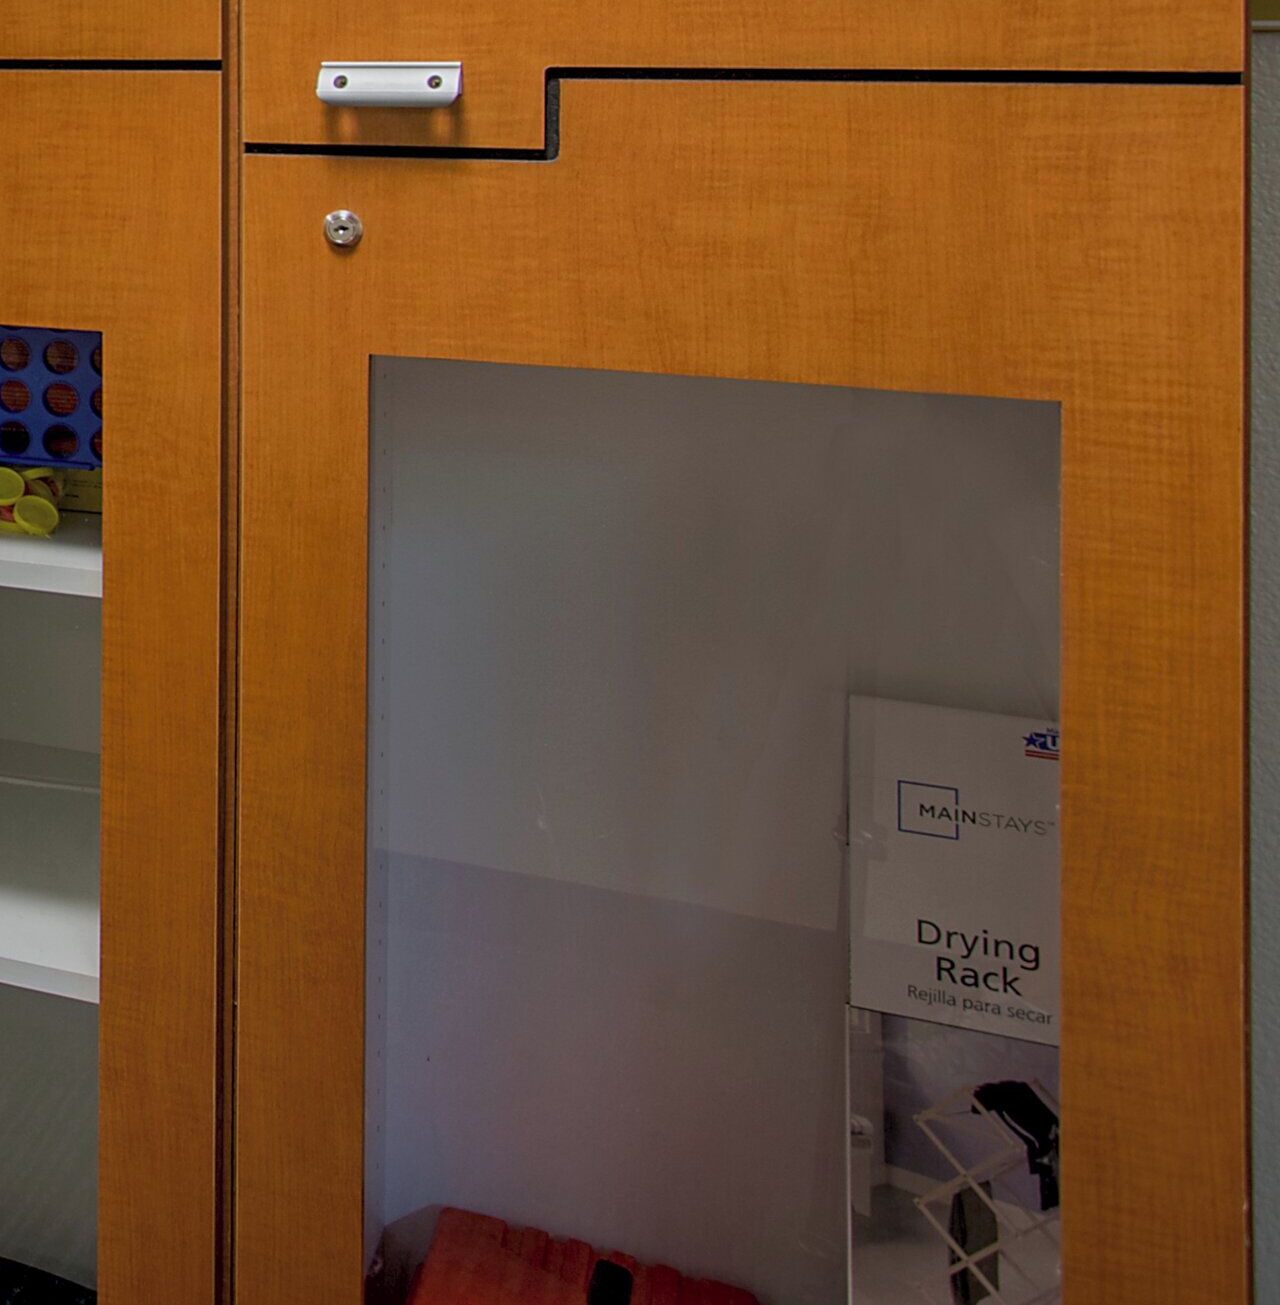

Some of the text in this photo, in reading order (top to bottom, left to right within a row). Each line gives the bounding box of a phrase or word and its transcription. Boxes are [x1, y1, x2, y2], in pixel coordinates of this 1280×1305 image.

[919, 803, 1048, 835] MAINSTAYS
[916, 919, 1041, 971] Drying
[935, 956, 1023, 996] Rack
[907, 985, 1053, 1025] Rejilla para secar
